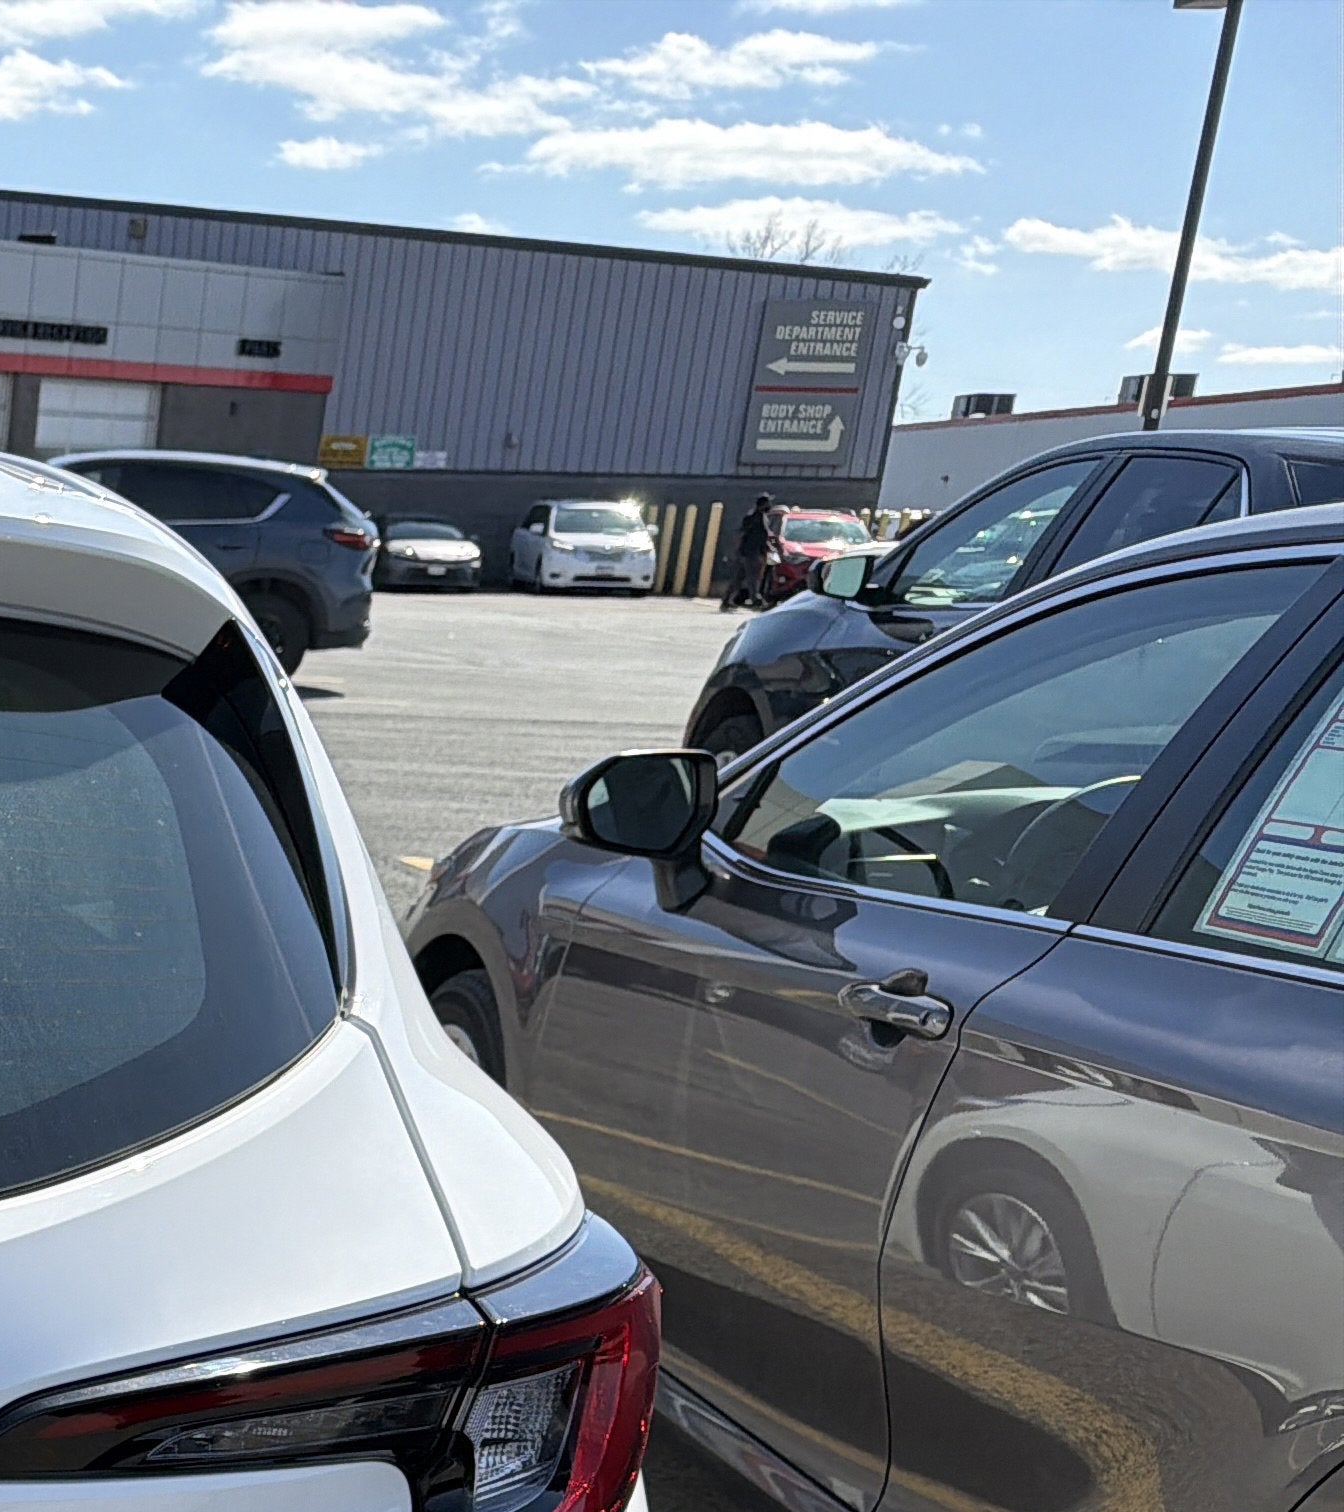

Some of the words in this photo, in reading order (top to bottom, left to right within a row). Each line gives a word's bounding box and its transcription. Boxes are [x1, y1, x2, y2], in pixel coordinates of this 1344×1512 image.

[810, 310, 864, 325] SERVICE
[775, 325, 862, 341] DEPARTMENT
[790, 341, 858, 356] ENTRANCE
[762, 403, 795, 418] BODY
[798, 403, 832, 419] SHOP
[758, 419, 824, 434] ENTRANCE
